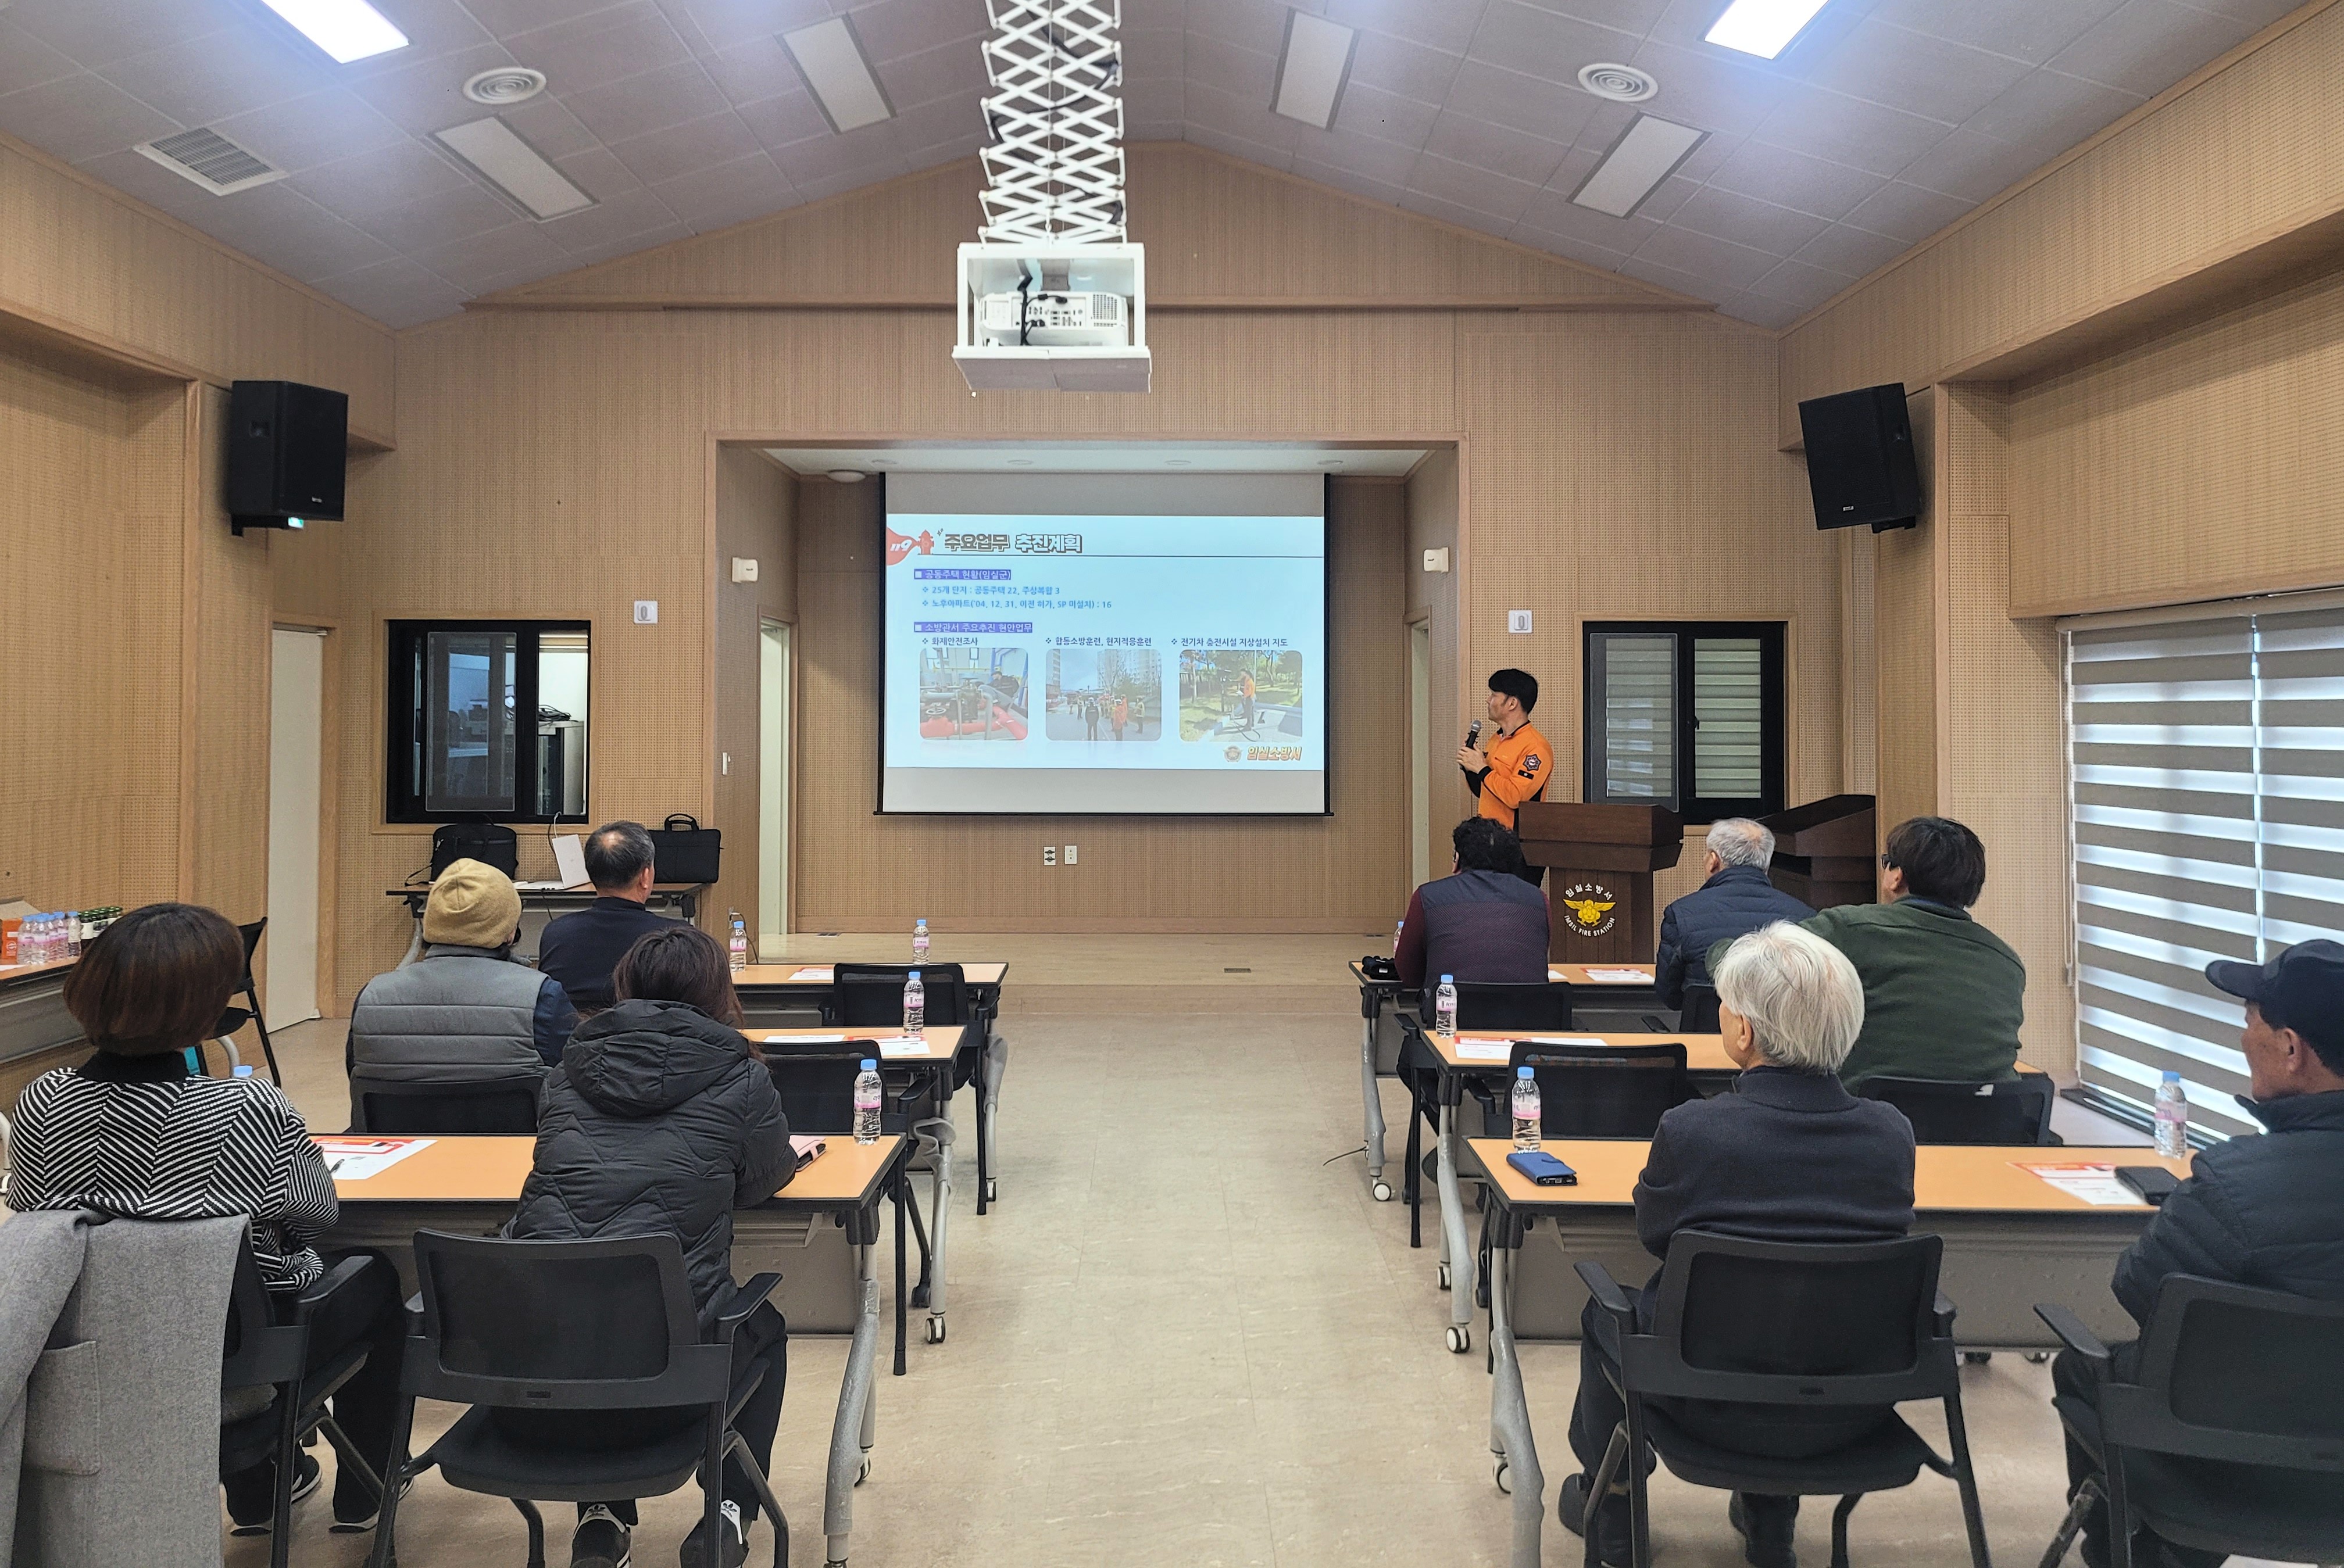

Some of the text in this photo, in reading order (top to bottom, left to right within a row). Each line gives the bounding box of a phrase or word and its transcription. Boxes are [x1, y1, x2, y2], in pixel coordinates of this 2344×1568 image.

[890, 539, 912, 552] 119
[944, 534, 1082, 553] 주요업무 추진계획
[925, 570, 1010, 580] 공동주택 현황(임실군)
[932, 586, 949, 595] 25개
[952, 586, 967, 595] 단지
[975, 586, 1005, 595] 공동주택
[1022, 586, 1053, 595] 주상복합
[1069, 600, 1094, 609] 미설치)
[925, 623, 1032, 633] 소방관서 주요추진 현안업무
[931, 637, 978, 646] 화재안전조사
[1106, 637, 1152, 646] 현지적응훈련
[1181, 638, 1288, 647] 전기차 충전시설 지상설치 지도
[1247, 746, 1302, 761] 임실소방서
[1565, 883, 1613, 900] 임실소방서
[1564, 915, 1615, 936] IMSIL FIRE STATION
